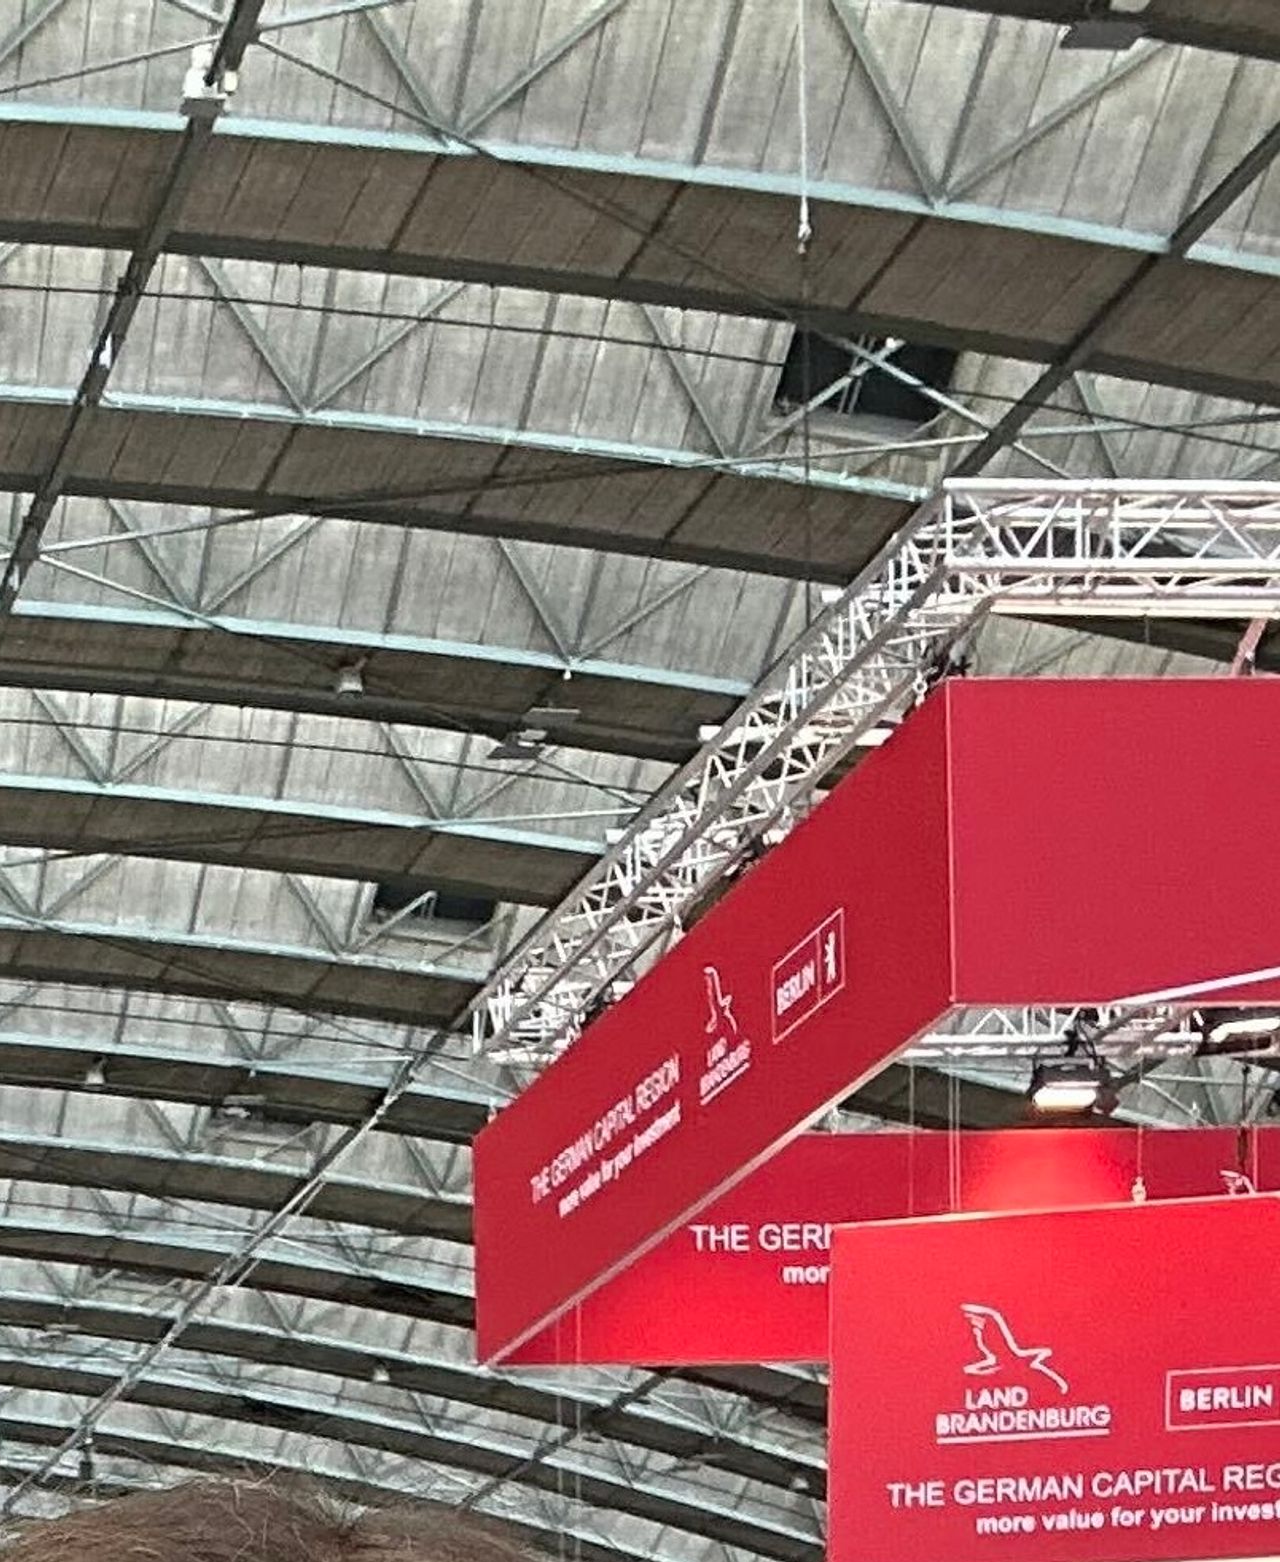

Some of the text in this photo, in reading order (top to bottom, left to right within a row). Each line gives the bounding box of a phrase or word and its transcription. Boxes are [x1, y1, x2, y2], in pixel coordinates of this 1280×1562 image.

[689, 1222, 833, 1252] THE GER
[965, 1386, 1028, 1410] LAND
[1179, 1384, 1273, 1412] BERLIN
[936, 1405, 1111, 1435] BRANDENBURG
[886, 1480, 946, 1508] THE
[953, 1472, 1084, 1505] GERMAN
[1092, 1467, 1216, 1498] CAPITAL
[976, 1514, 1036, 1534] more
[1041, 1508, 1104, 1531] value
[1111, 1506, 1144, 1527] for
[1150, 1505, 1205, 1530] your
